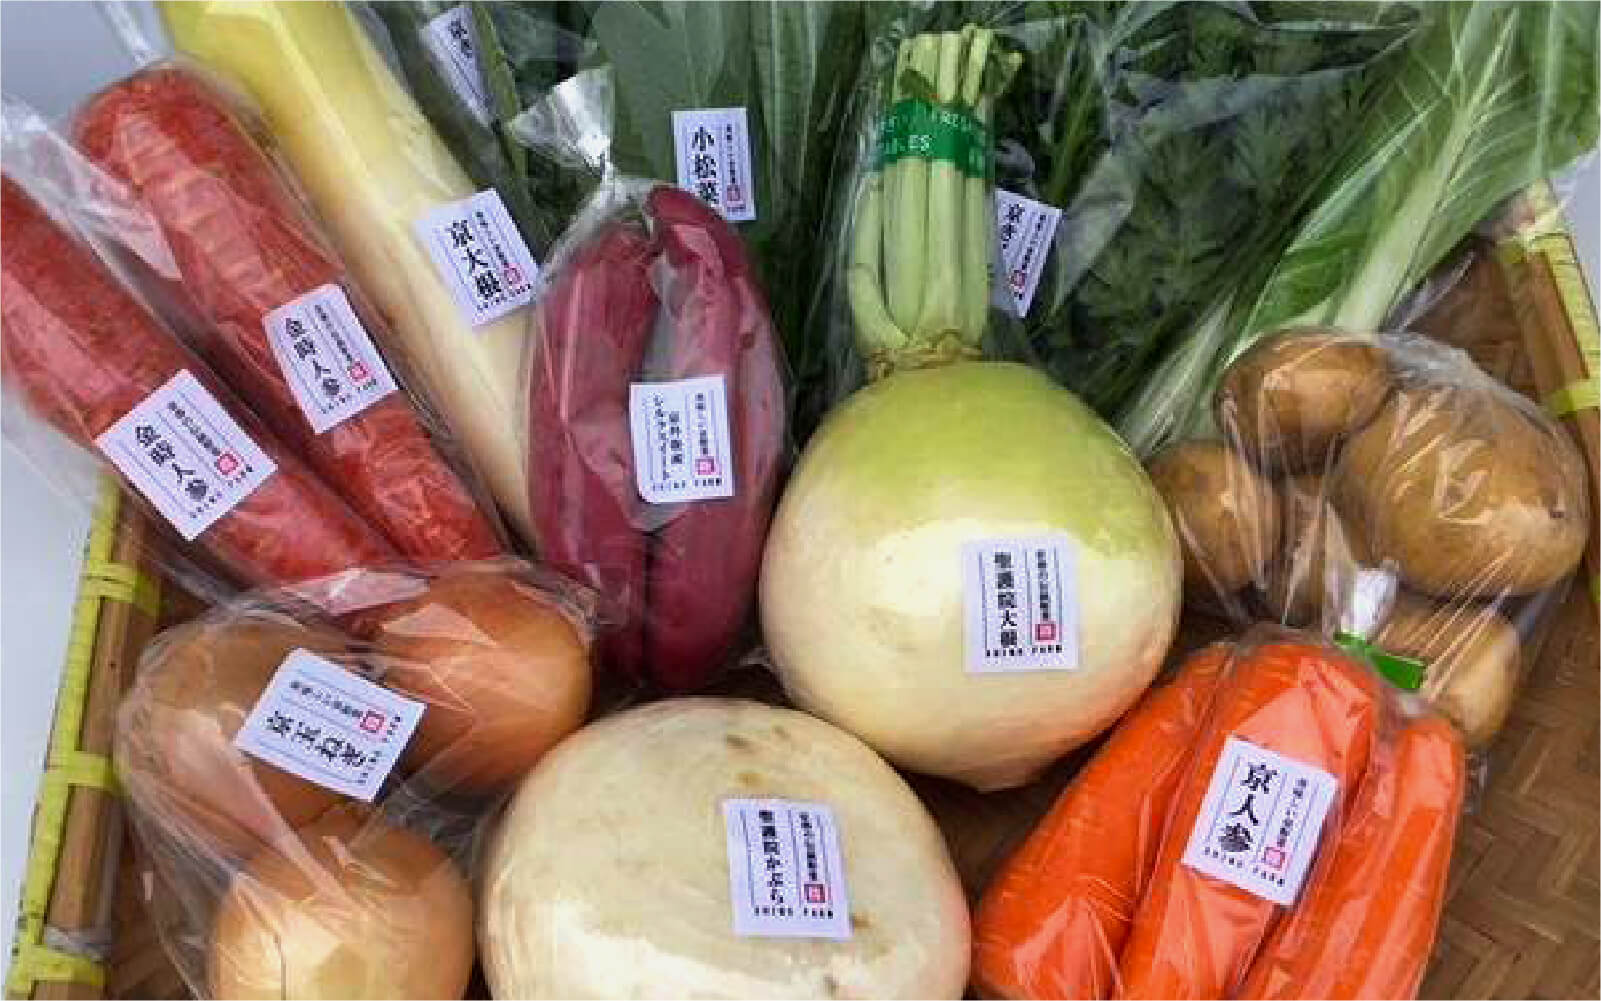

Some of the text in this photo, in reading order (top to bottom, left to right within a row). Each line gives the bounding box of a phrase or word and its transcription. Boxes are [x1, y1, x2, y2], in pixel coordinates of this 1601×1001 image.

[691, 126, 720, 206] 小松菜
[446, 219, 501, 300] 京大根
[285, 317, 341, 397] 金時人参
[134, 425, 209, 500] 金時人参
[994, 551, 1018, 648] 聖護院大根
[265, 709, 368, 768] 京玉ねぎ
[1217, 762, 1278, 852] 京人参
[758, 809, 784, 904] 聖護院かぶら
